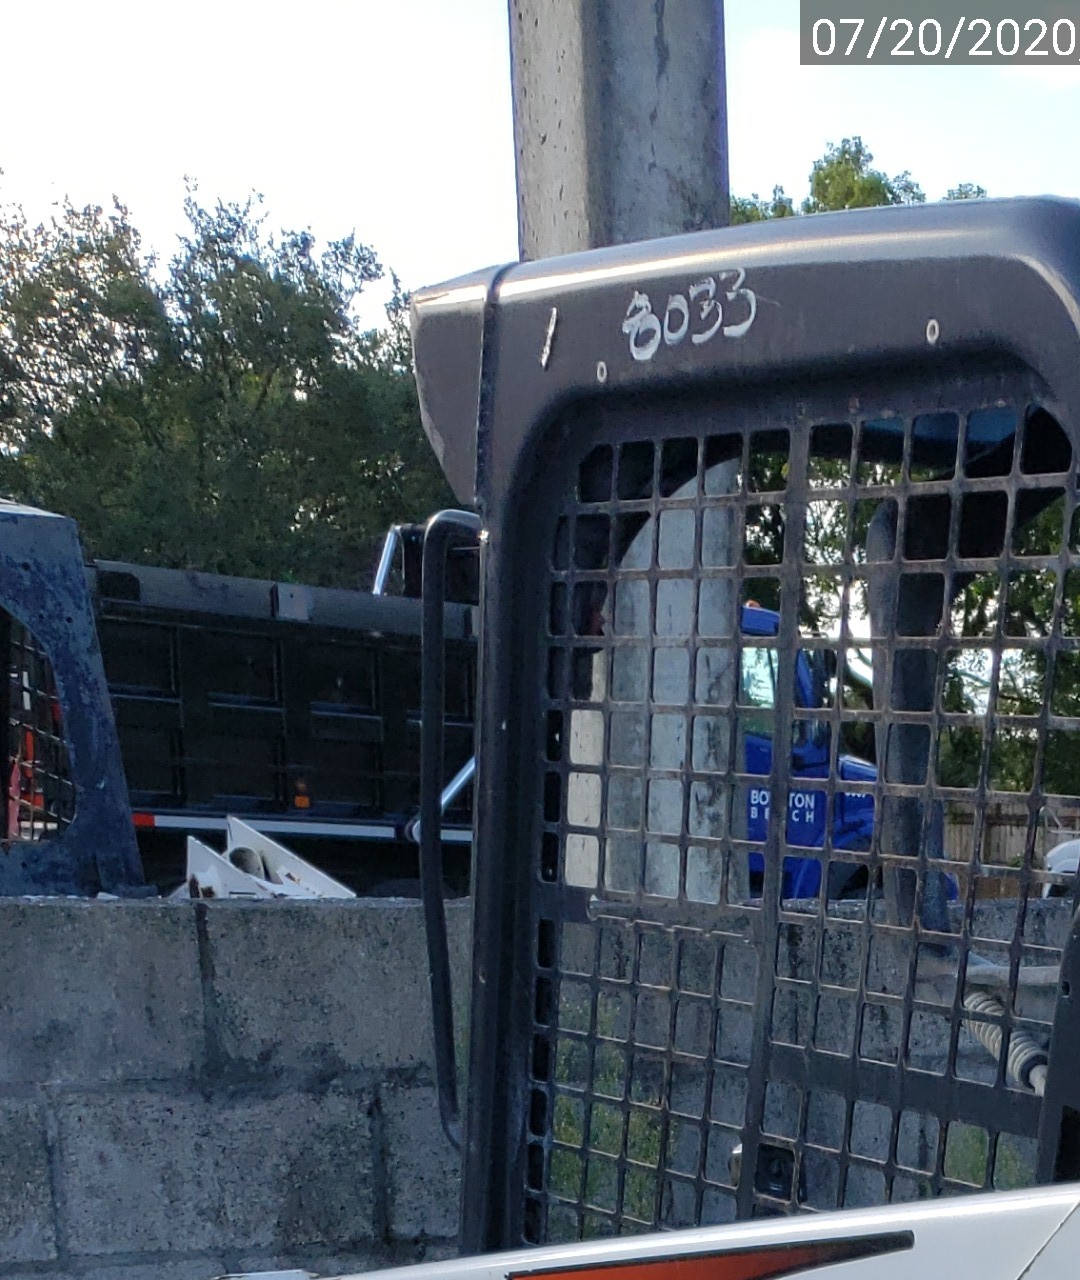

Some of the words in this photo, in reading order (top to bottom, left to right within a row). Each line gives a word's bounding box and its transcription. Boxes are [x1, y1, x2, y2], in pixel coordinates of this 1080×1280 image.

[622, 267, 757, 360] 8033
[750, 789, 816, 809] BOTON
[750, 806, 815, 823] BECH
